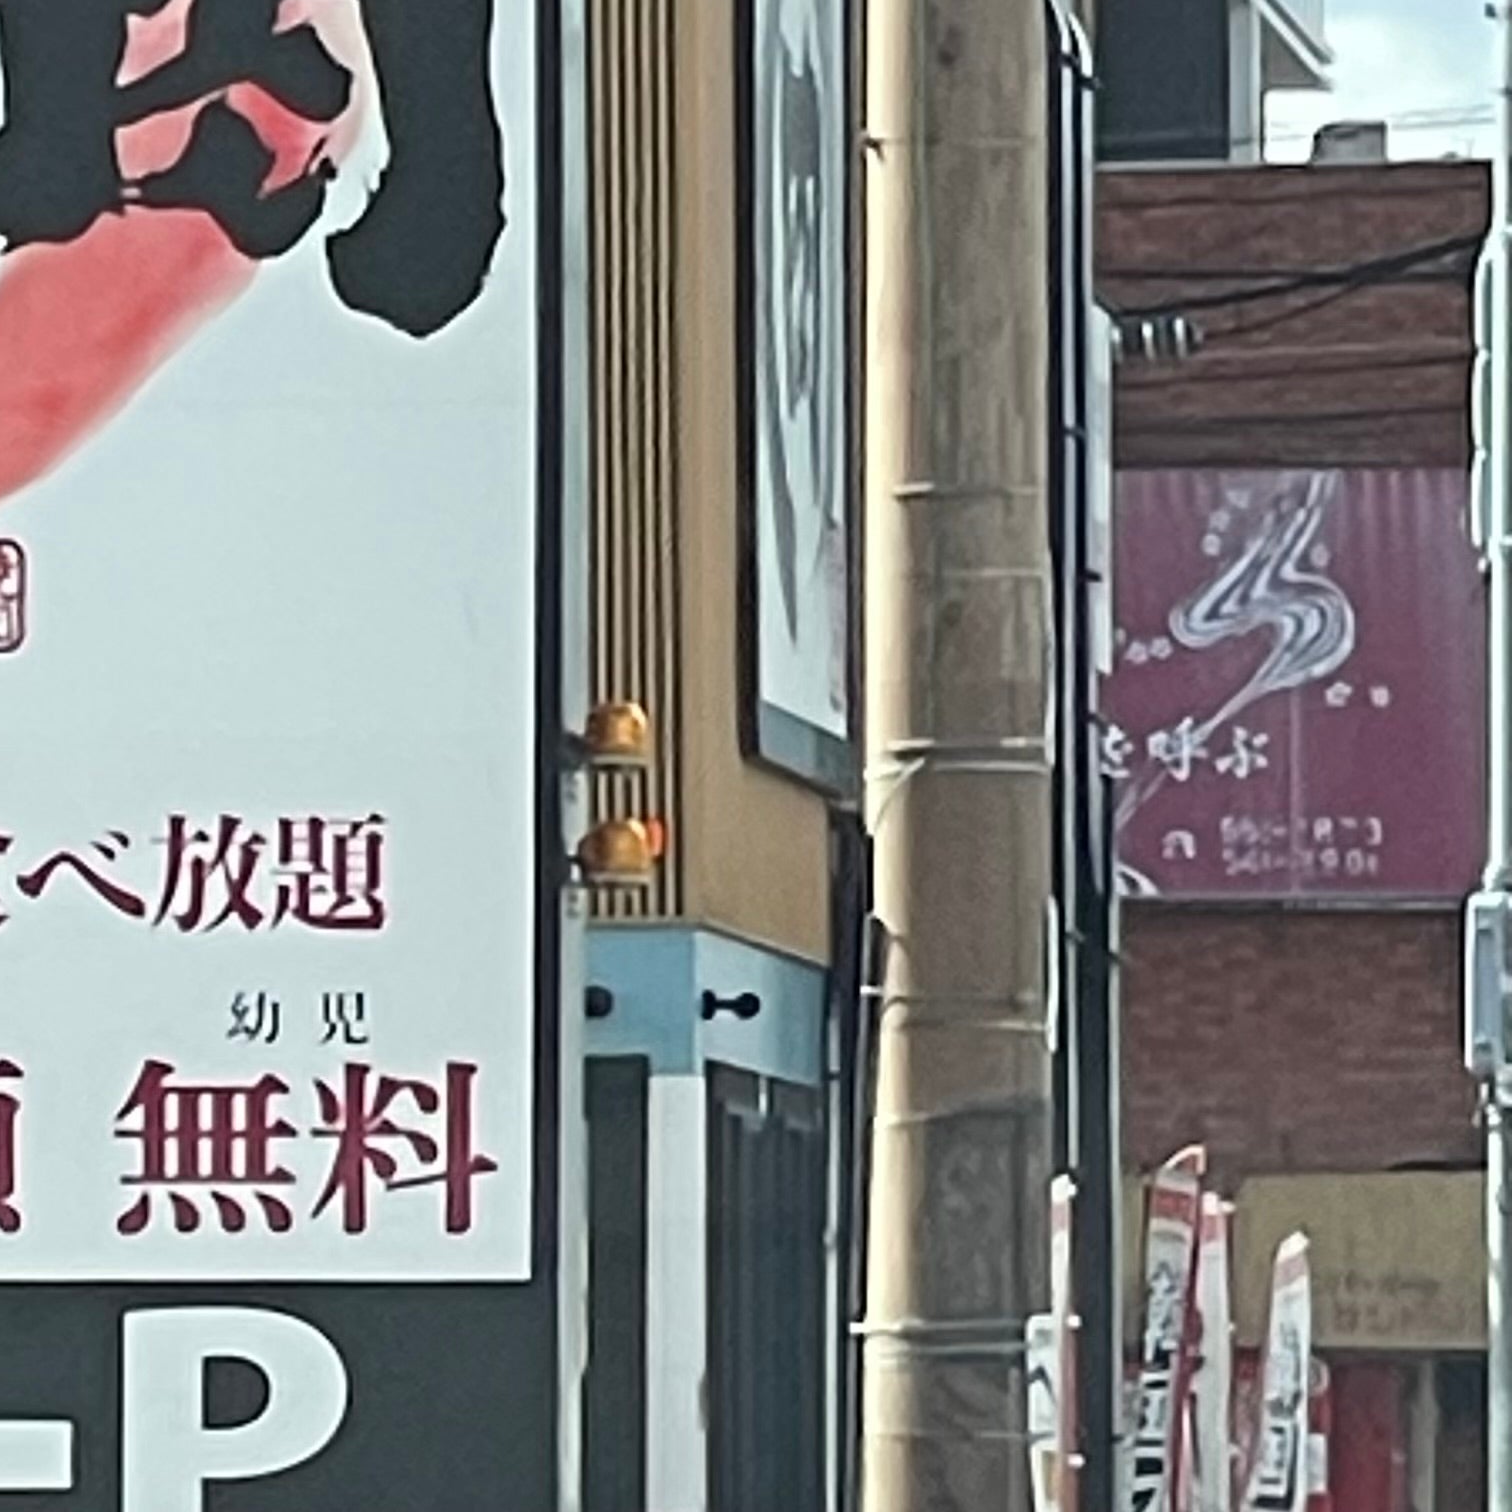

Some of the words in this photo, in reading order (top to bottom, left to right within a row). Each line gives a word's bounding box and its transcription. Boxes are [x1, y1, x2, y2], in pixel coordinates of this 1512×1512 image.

[226, 988, 371, 1046] 幼児
[114, 1058, 499, 1236] 無料
[123, 1304, 349, 1512] P
